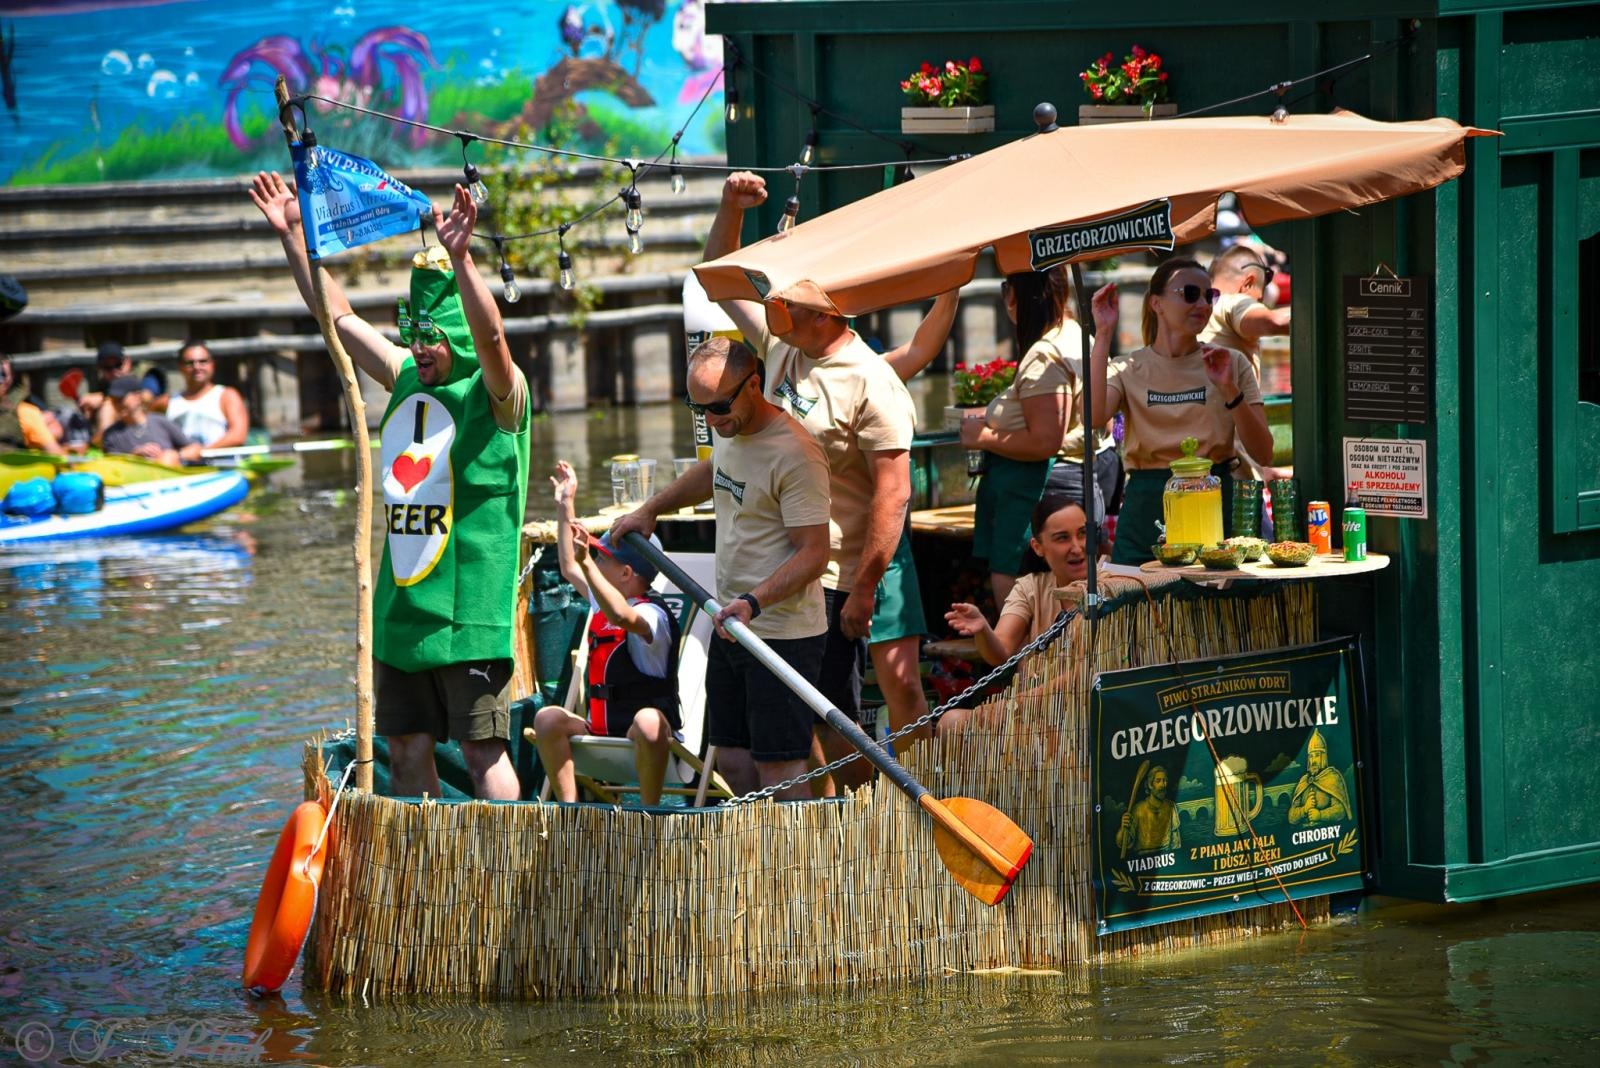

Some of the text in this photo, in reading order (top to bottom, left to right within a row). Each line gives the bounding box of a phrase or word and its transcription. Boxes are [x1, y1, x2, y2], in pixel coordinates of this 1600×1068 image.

[315, 202, 355, 221] Viadrus
[1036, 213, 1166, 257] GRZEGORZOWICKIE
[1369, 281, 1402, 294] Cennik
[1149, 391, 1204, 403] GRZEGORZOWICKIE
[413, 401, 427, 444] I
[1349, 454, 1374, 462] OSOBOM
[1354, 445, 1379, 453] OSOBOM
[1392, 446, 1402, 454] LAT
[1365, 471, 1406, 480] ALKOHOLU
[1366, 481, 1420, 491] SPRZEDAJEMY
[385, 503, 448, 535] EER
[1163, 676, 1287, 708] PIWO STRAŻNIKÓW ODRY
[1111, 696, 1339, 760] GRZEGORZOWICKIE
[1292, 825, 1341, 846] CHROBRY
[1190, 848, 1198, 860] Z
[1232, 837, 1251, 853] JAK
[1213, 858, 1218, 871] I
[1253, 847, 1281, 864] RZEKI
[1127, 853, 1175, 873] VIADRUS
[1144, 881, 1150, 891] Z
[1151, 878, 1206, 891] GRZEGORZOWIC
[1213, 874, 1236, 887] PRZEZ
[1236, 870, 1258, 883] WIEKI
[1264, 862, 1292, 877] PROSTO
[1293, 859, 1303, 870] DO
[1304, 851, 1328, 867] KUFLA
